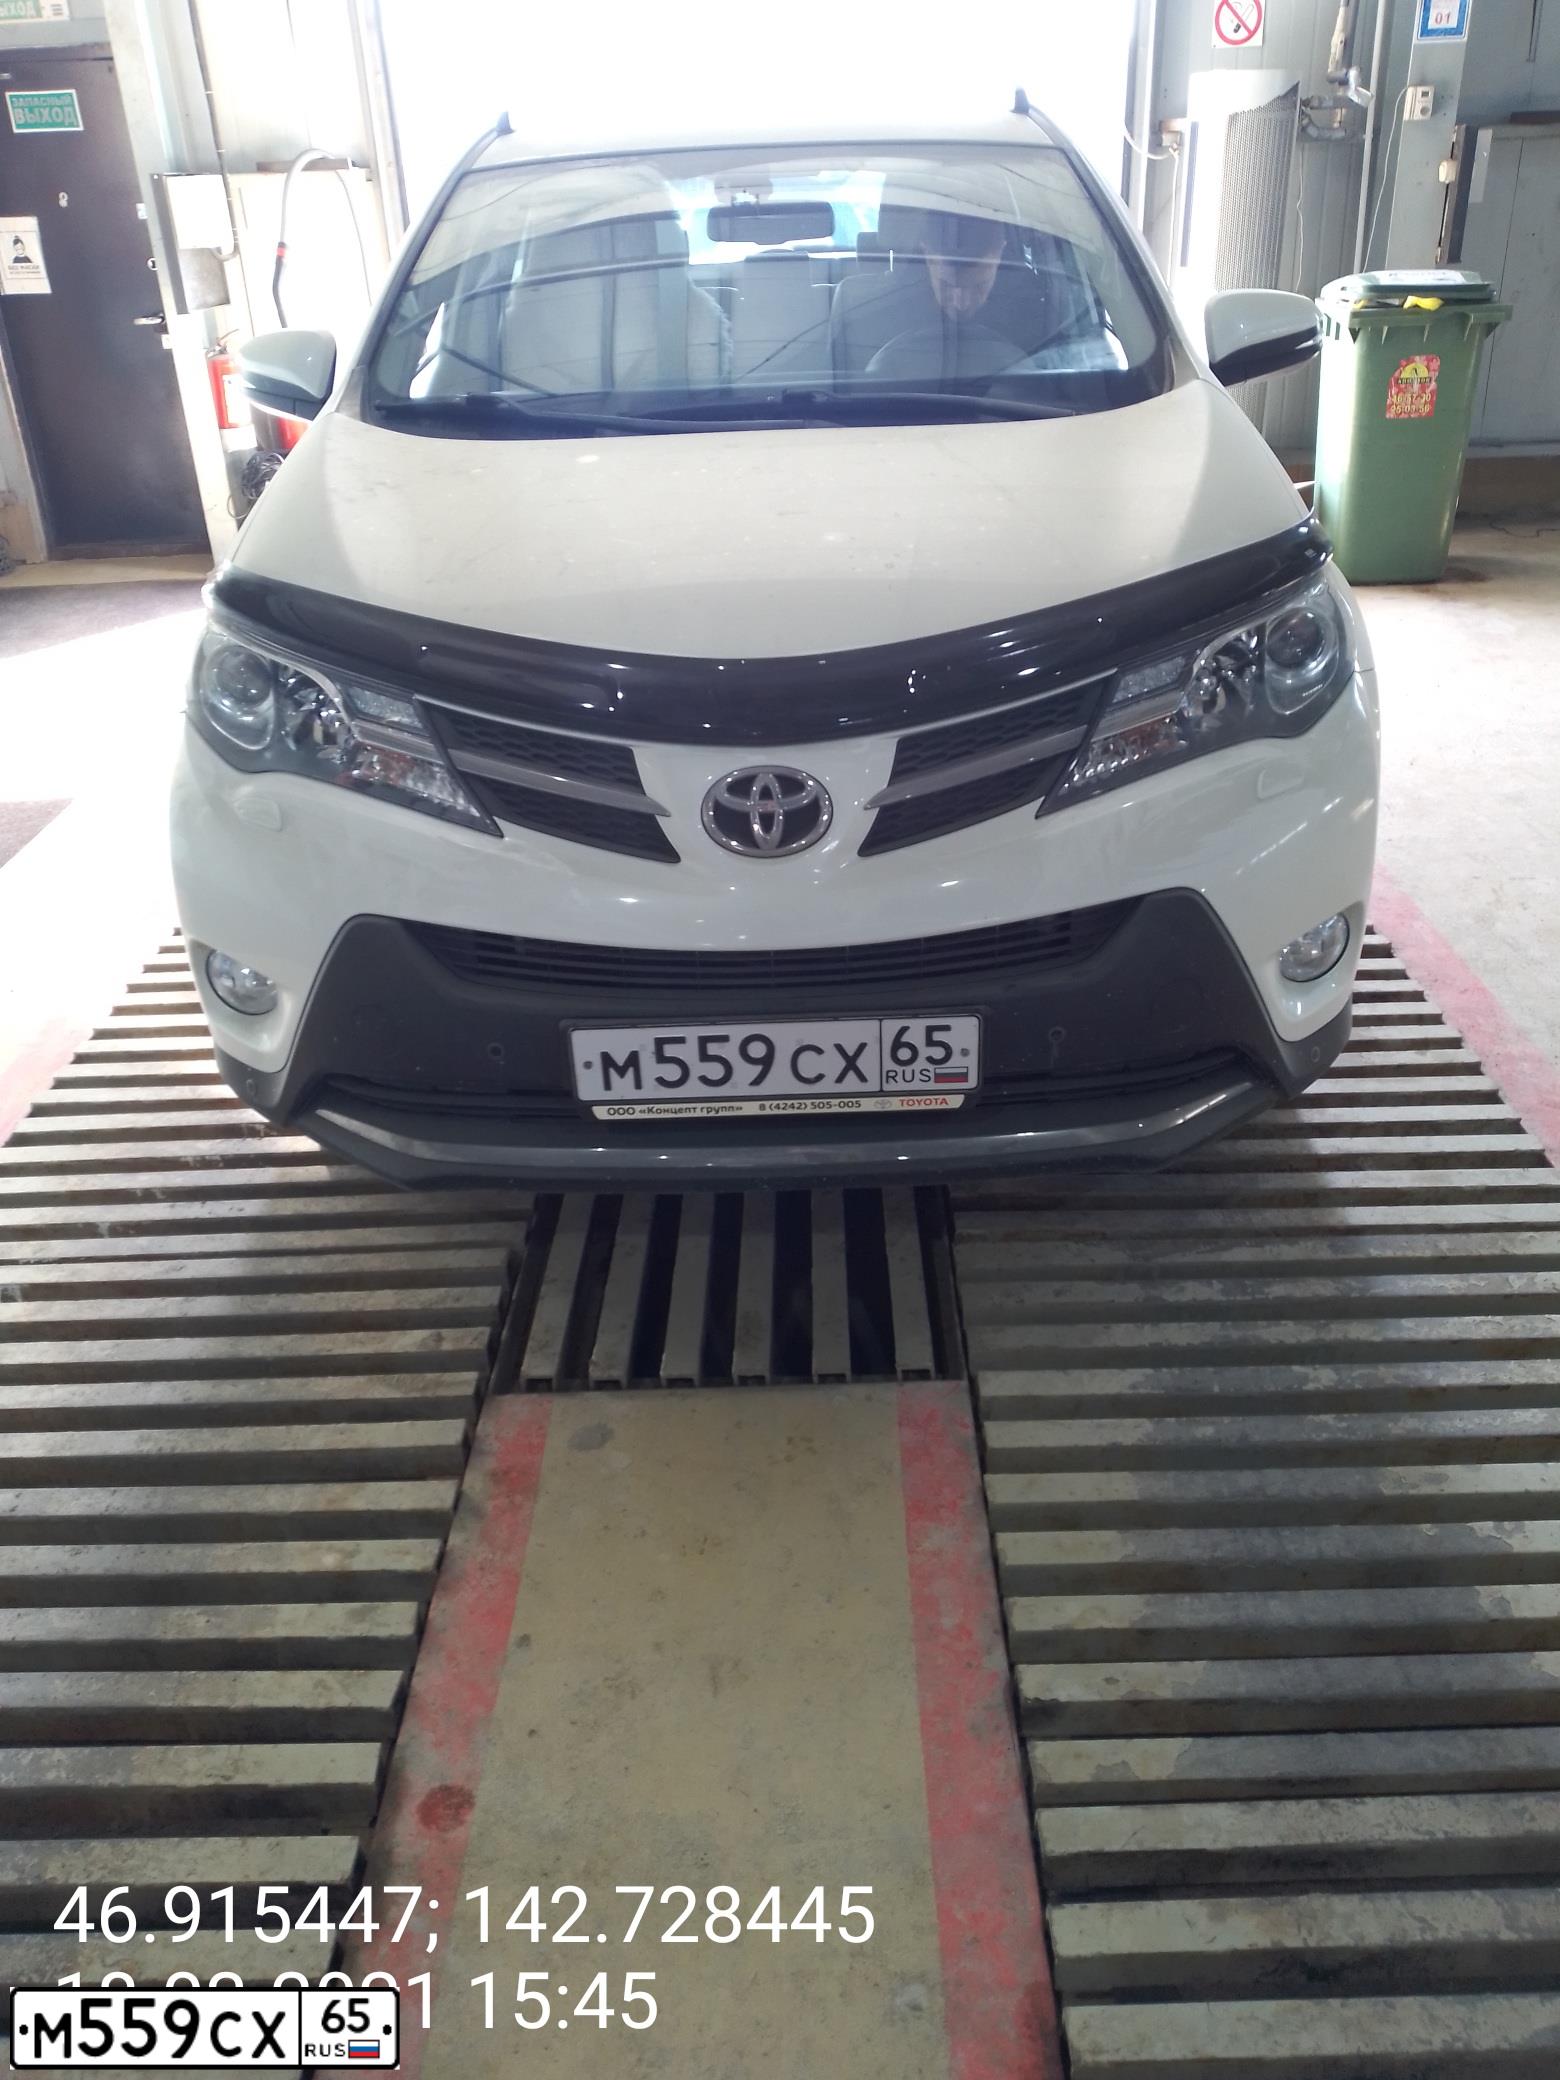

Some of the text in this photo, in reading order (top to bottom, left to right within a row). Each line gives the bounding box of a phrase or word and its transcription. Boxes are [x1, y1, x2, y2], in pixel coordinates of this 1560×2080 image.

[1434, 11, 1451, 25] 01
[12, 95, 73, 107] ЗАПАСНЫЙ
[14, 106, 78, 126] ВЫХОД
[889, 1025, 953, 1066] 65
[886, 1069, 931, 1084] RUS
[607, 1099, 861, 1116] ООО «Концепт групп» 8 (4242) 505-005
[899, 1096, 949, 1107] TOYOTA
